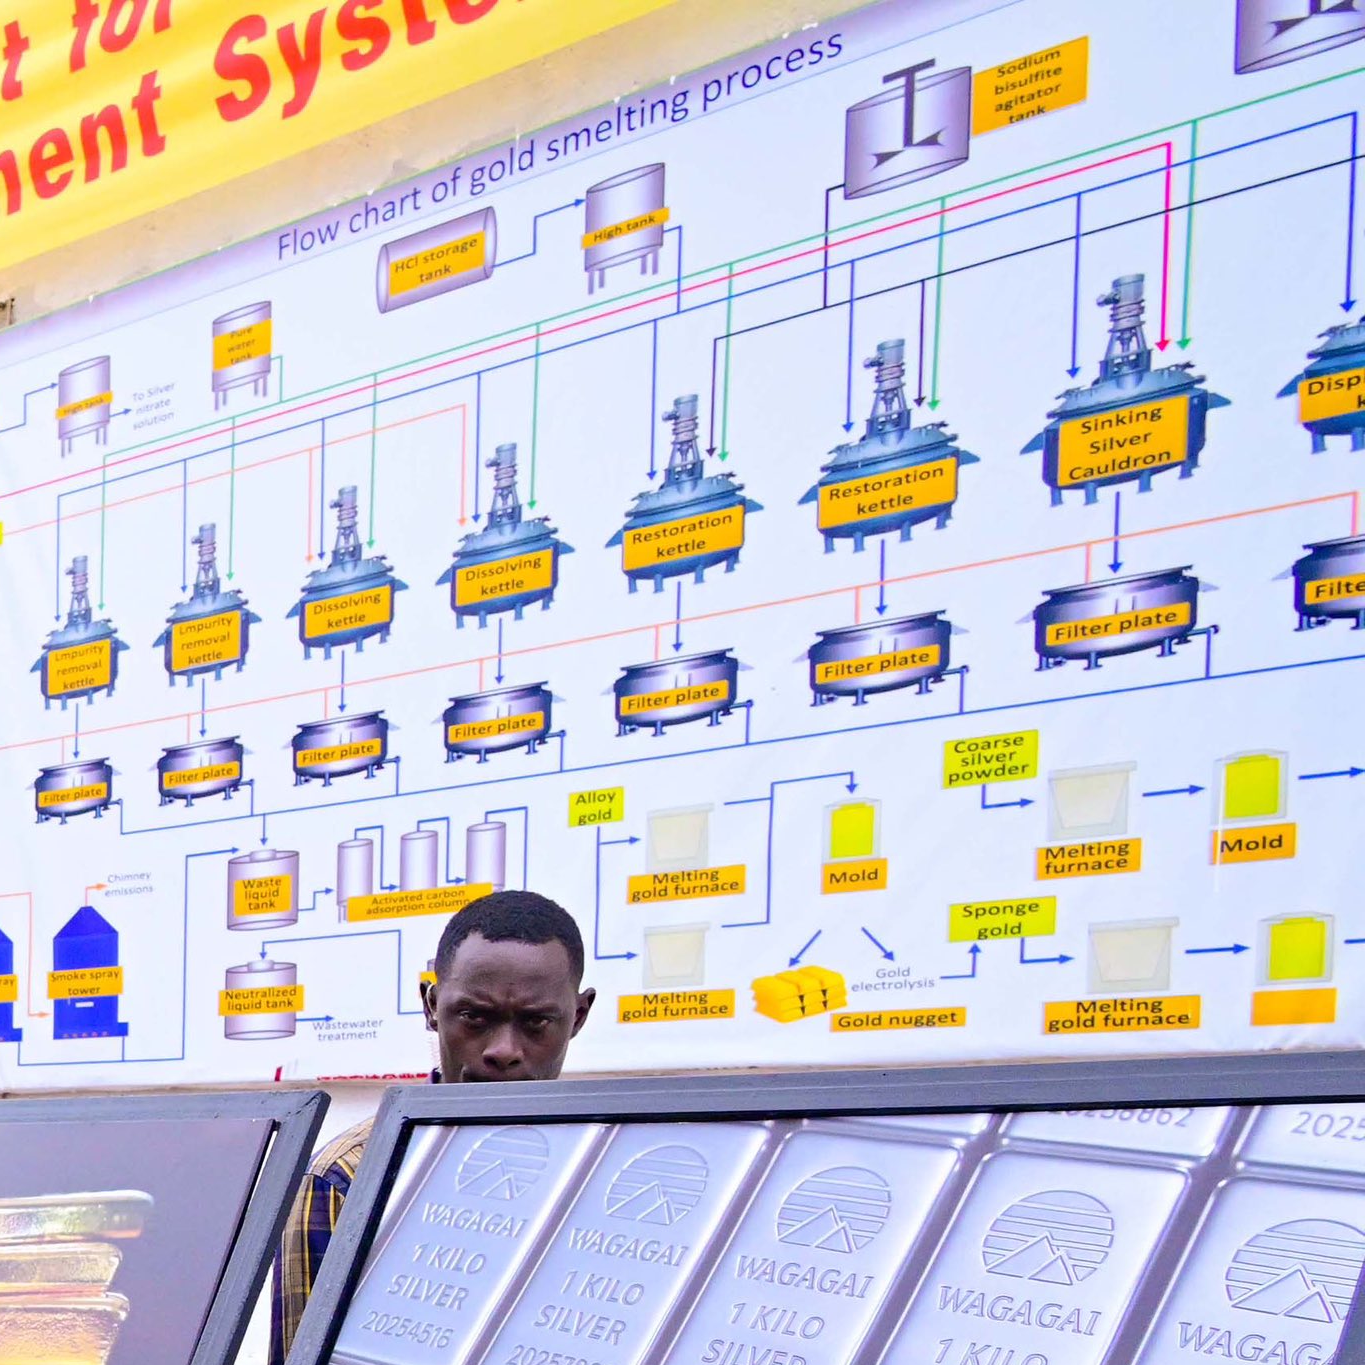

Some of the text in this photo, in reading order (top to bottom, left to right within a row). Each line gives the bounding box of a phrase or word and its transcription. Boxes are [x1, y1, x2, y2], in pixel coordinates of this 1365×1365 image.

[997, 49, 1061, 77] Sodium
[994, 65, 1062, 95] bisulfite
[994, 82, 1061, 112] agitator
[1009, 105, 1046, 124] tank
[278, 33, 843, 260] Flow chart of gold smelting process
[593, 215, 657, 244] High tank
[423, 238, 478, 267] storage
[418, 263, 451, 284] tank
[133, 412, 175, 430] solution
[1081, 406, 1163, 435] Sinking
[1089, 431, 1152, 455] Silver
[1069, 449, 1171, 482] Cauldron
[829, 465, 944, 501] Restoration
[857, 492, 913, 516] kettle
[632, 513, 732, 545] Restoration
[656, 537, 706, 559] kettle
[465, 556, 542, 582] Dissolving
[481, 578, 524, 596] kettle
[313, 592, 381, 615] Dissolving
[327, 612, 366, 629] kettle
[1055, 608, 1177, 641] Filter plate
[181, 633, 230, 651] removal
[188, 650, 223, 665] kettle
[824, 649, 930, 679] Filter plate
[57, 660, 102, 677] removal
[63, 675, 95, 691] kettle
[627, 685, 719, 710] Filter plate
[454, 716, 536, 739] Filter plate
[302, 743, 374, 764] Filter plate
[954, 735, 1024, 753] Coarse
[960, 749, 1017, 767] silver
[169, 765, 233, 784] Filter plate
[948, 762, 1029, 785] powder
[575, 791, 616, 806] Alloy
[578, 808, 612, 826] gold
[1045, 842, 1130, 861] Melting
[1221, 834, 1284, 854] Mold
[1045, 856, 1128, 874] furnace
[242, 876, 282, 890] Waste
[652, 869, 719, 885] Melting
[830, 868, 879, 884] Mold
[245, 887, 281, 902] liquid
[372, 889, 465, 905] Activated carbon
[632, 878, 739, 902] gold furnace
[248, 898, 276, 911] tank
[367, 902, 425, 915] adsorption
[962, 900, 1040, 919] Sponge
[977, 922, 1022, 941] gold
[50, 969, 120, 984] Smoke spray
[875, 967, 911, 979] Gold
[67, 984, 101, 996] tower
[225, 987, 297, 1001] Neutralized
[851, 977, 936, 993] electrolysis
[227, 996, 294, 1012] liquid tank
[642, 992, 709, 1005] Melting
[1075, 998, 1163, 1015] Melting
[622, 1001, 729, 1021] gold furnace
[838, 1011, 957, 1028] Gold nugget
[313, 1018, 383, 1033] Wastewater
[1048, 1011, 1191, 1033] gold furnace
[318, 1028, 378, 1041] treatment
[421, 1203, 528, 1239] WAGAGAI
[569, 1228, 689, 1267] WAGAGAI
[427, 1246, 487, 1275] KILO
[734, 1255, 874, 1299] WAGAGAI
[387, 1273, 470, 1311] SILVER
[578, 1274, 645, 1306] KILO
[938, 1285, 1101, 1336] WAGAGAI
[361, 1311, 454, 1350] 20254516
[534, 1305, 627, 1346] SILVER
[751, 1305, 825, 1339] KILO
